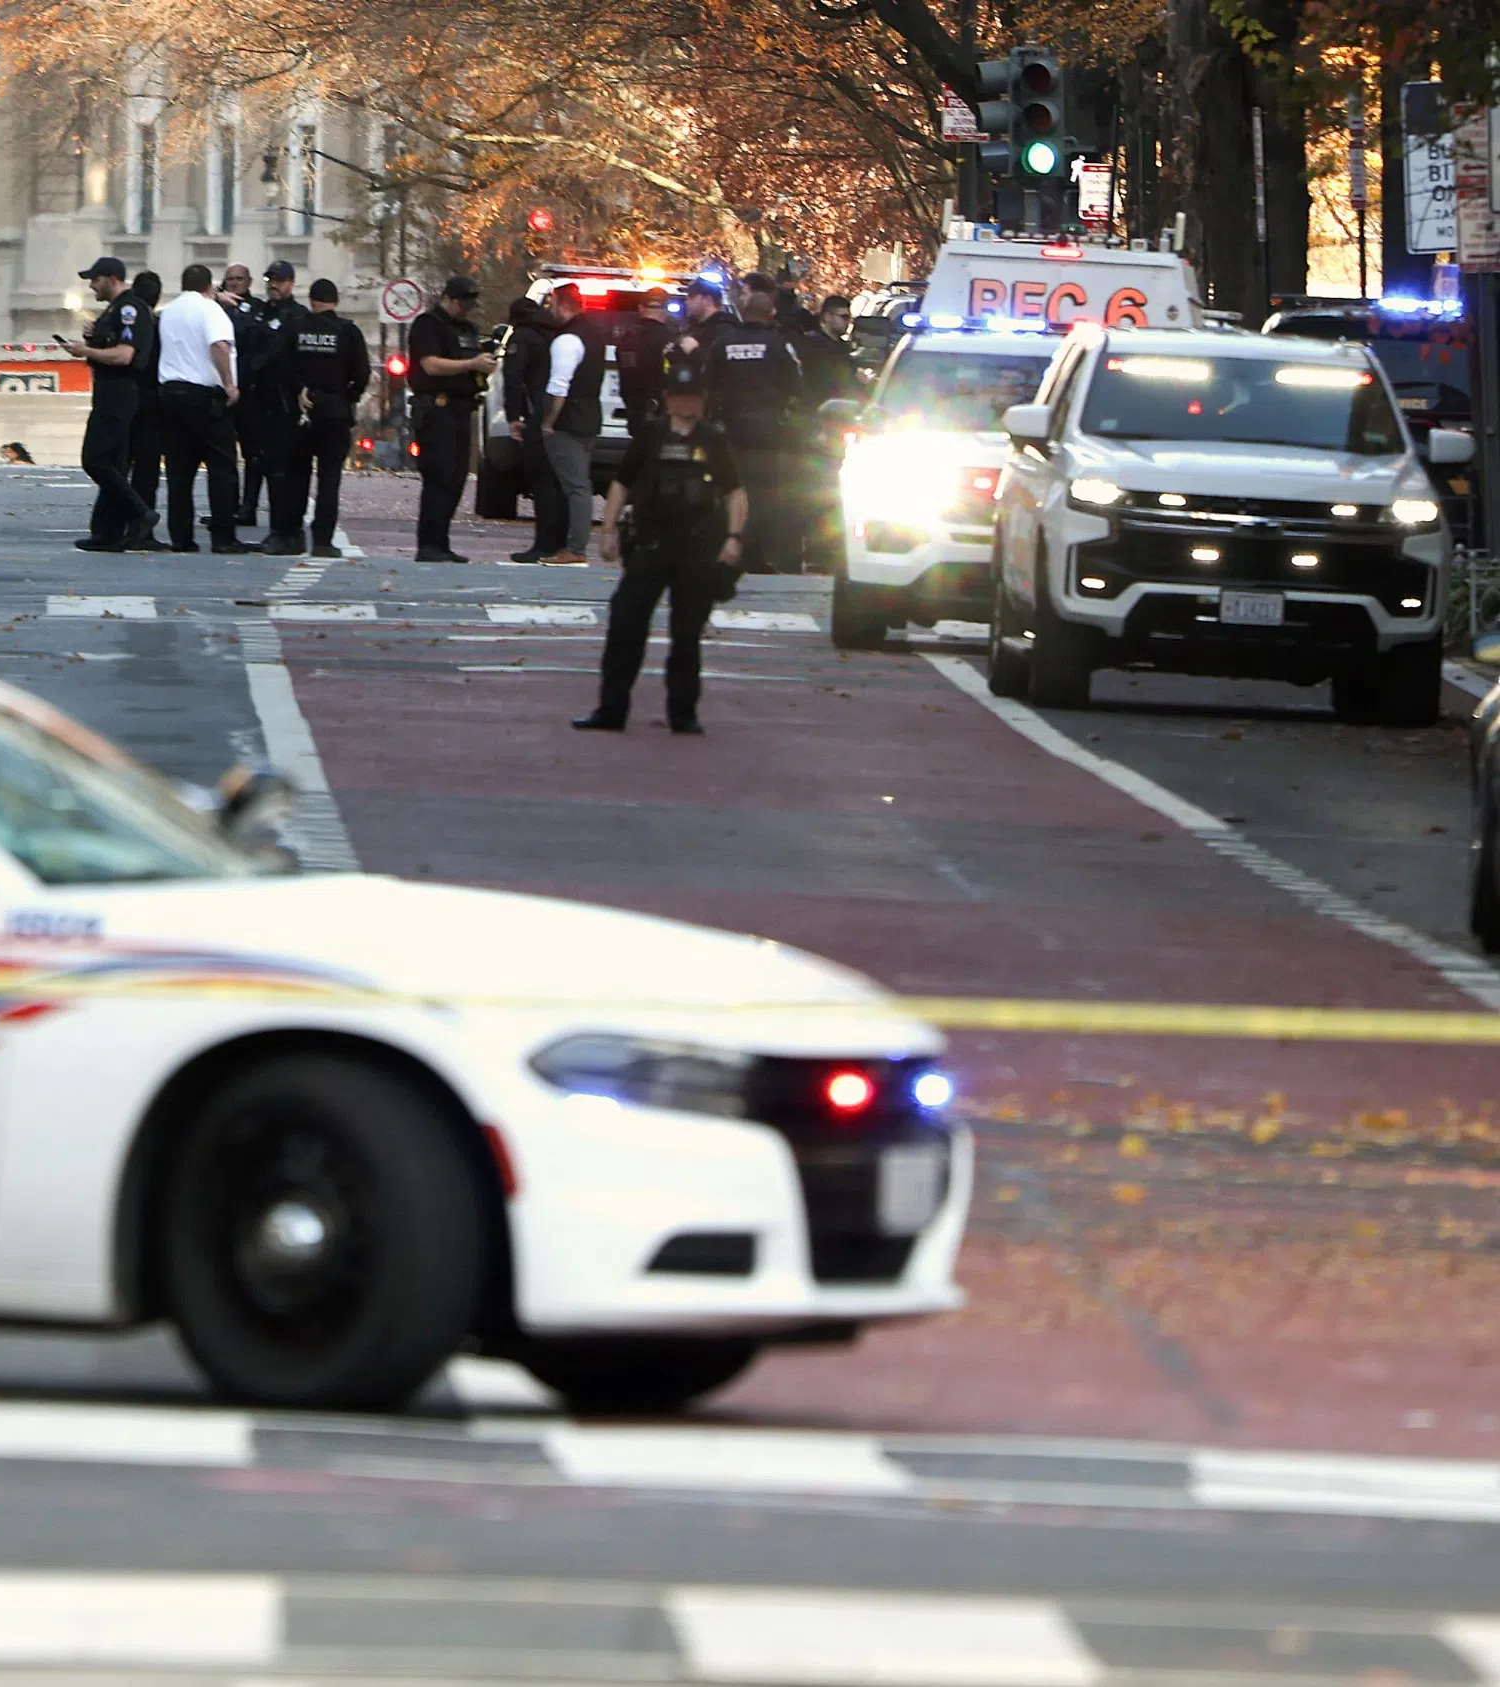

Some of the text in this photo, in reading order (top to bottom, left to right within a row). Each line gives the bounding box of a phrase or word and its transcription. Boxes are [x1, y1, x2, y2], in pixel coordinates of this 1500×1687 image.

[970, 277, 1148, 328] REC 6
[298, 333, 337, 345] POLICE
